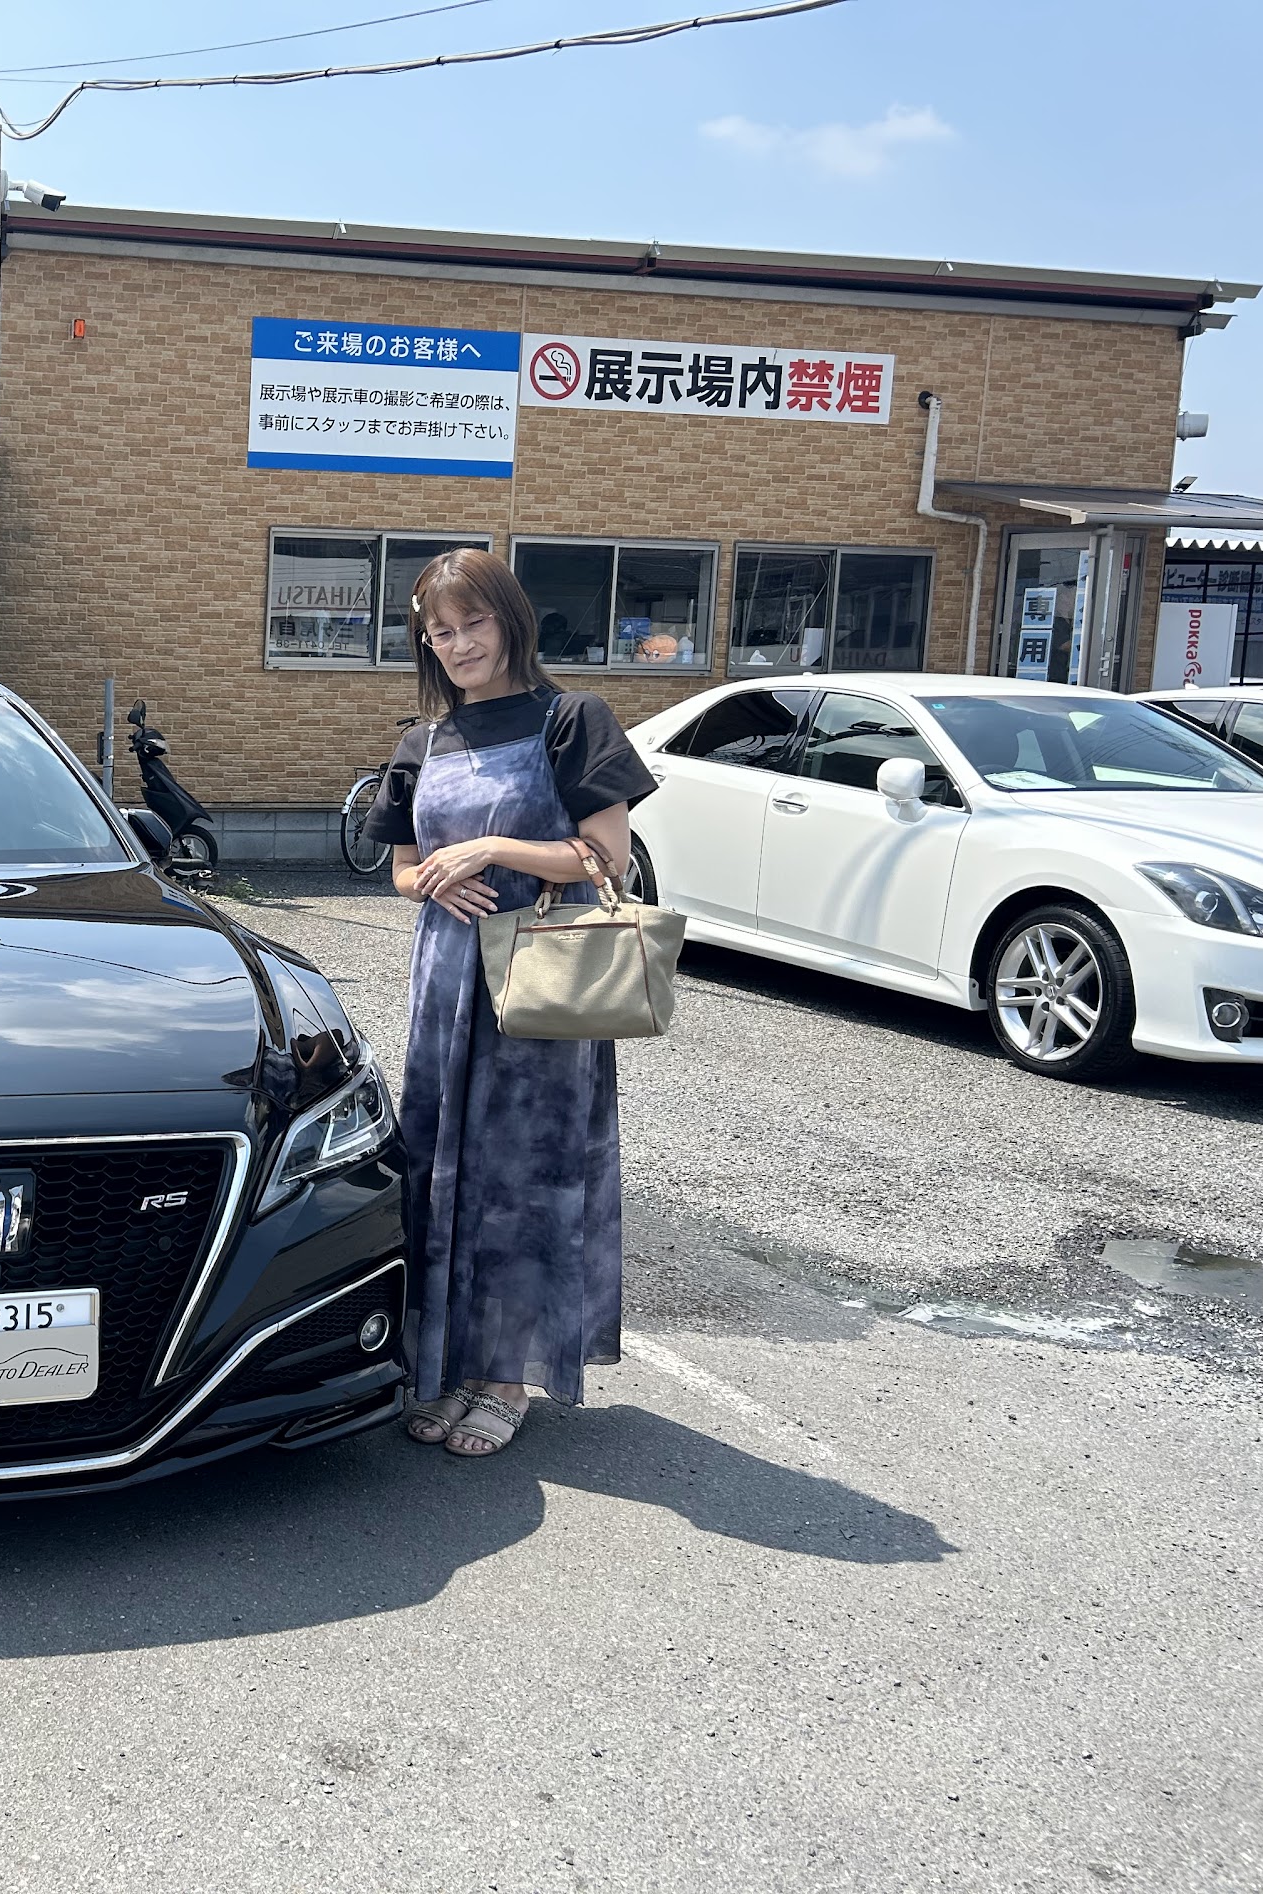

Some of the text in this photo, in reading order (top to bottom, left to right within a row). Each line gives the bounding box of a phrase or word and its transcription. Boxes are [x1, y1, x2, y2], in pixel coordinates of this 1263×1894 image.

[293, 330, 482, 362] ご来場のお客様へ
[584, 348, 884, 414] 展示場内禁煙
[259, 383, 511, 412] 展示場や展示車の撮影ご希望の際は、
[258, 413, 509, 440] 事前にスタッフまでお声掛け下さい。
[140, 1190, 189, 1212] RS
